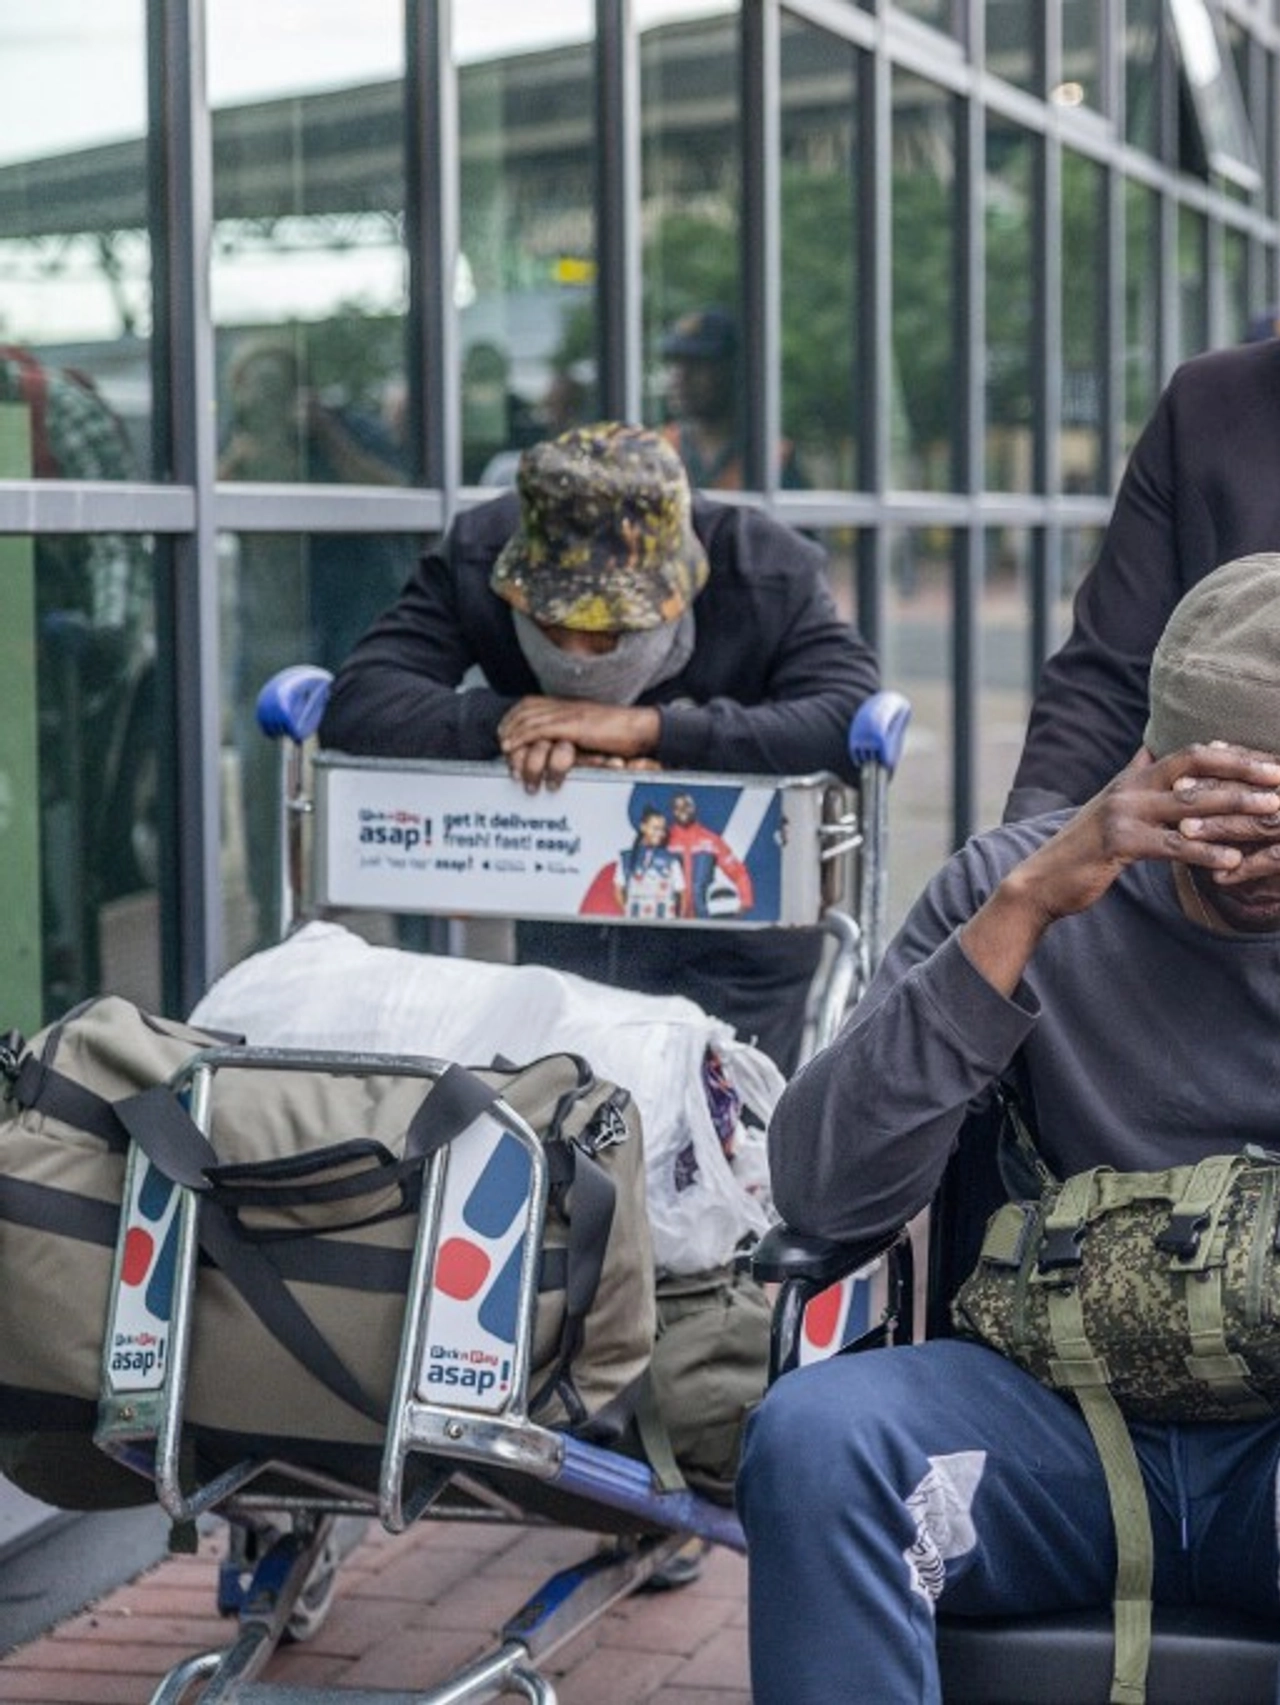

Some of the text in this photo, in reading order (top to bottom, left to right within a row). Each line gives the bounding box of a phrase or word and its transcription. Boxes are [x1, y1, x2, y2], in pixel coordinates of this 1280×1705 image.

[359, 817, 433, 851] asap!
[443, 813, 471, 835] get
[475, 814, 486, 829] it
[490, 813, 571, 832] delivered.
[443, 833, 581, 855] fresh! fast! easy!
[112, 1338, 165, 1377] asap!
[427, 1360, 510, 1396] asap!
